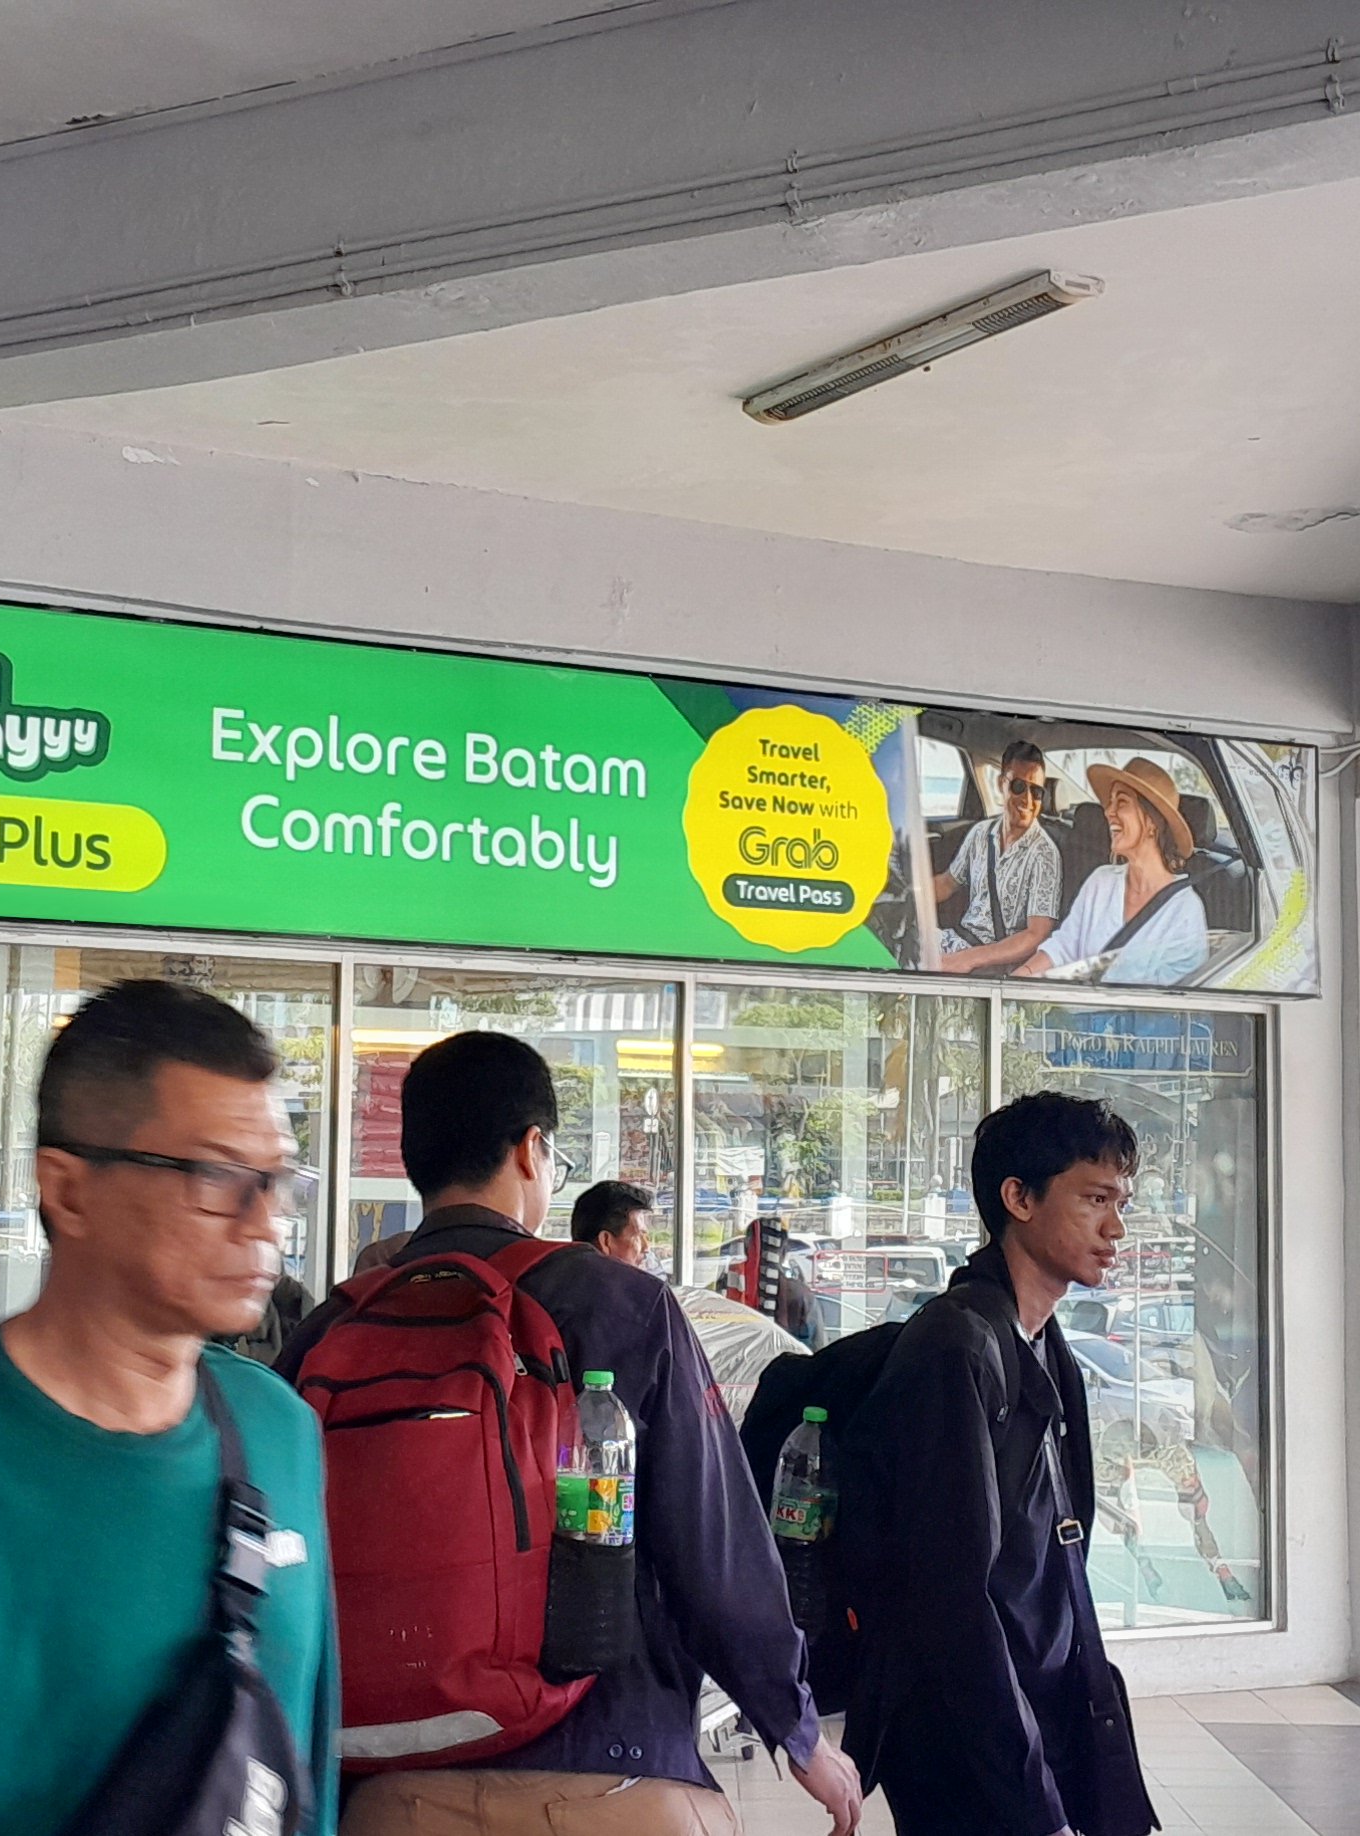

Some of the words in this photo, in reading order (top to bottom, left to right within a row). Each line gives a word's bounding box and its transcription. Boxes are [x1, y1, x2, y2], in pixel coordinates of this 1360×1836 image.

[210, 706, 448, 782] Explore
[463, 732, 647, 799] Batam
[758, 739, 821, 762] Travel
[746, 765, 831, 793] Smarter,
[718, 790, 767, 812] Save
[772, 796, 815, 816] Now
[819, 800, 858, 820] with
[240, 794, 619, 888] Comfortably
[737, 825, 840, 872] Grab
[735, 880, 796, 904] Travel
[799, 885, 843, 907] Pass
